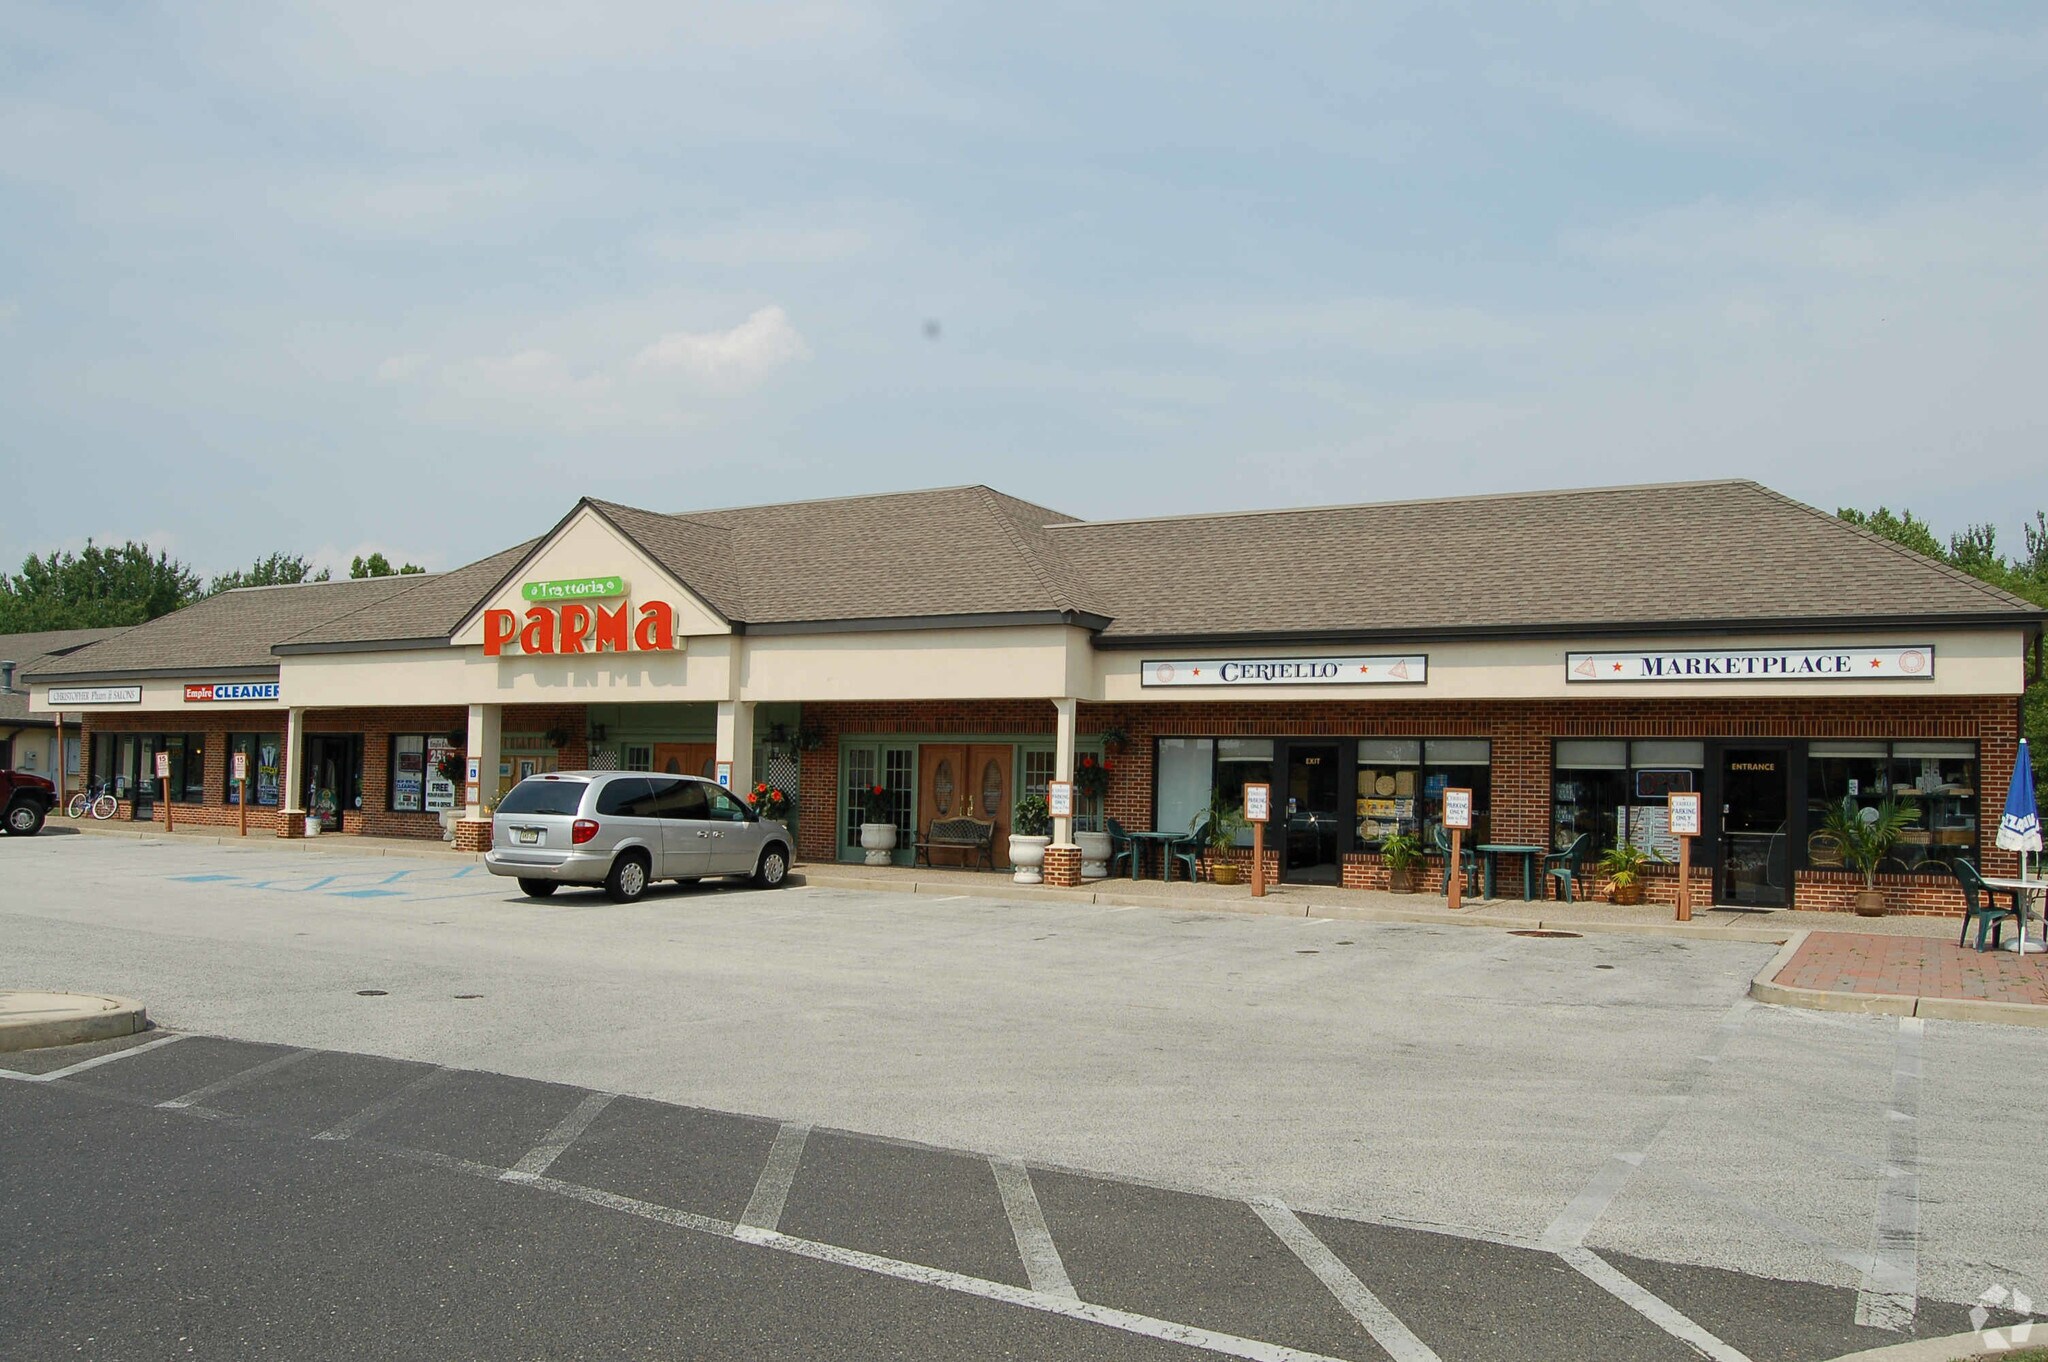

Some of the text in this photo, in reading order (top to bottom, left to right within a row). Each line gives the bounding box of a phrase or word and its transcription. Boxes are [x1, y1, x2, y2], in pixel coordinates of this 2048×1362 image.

[538, 580, 607, 597] Trattoria
[1219, 662, 1338, 682] CERIELLO
[1640, 655, 1852, 677] MARKETPLACE
[186, 687, 212, 700] Empire
[1305, 757, 1320, 765] EXIT
[1731, 763, 1775, 771] ENTRANCE
[431, 782, 449, 792] FREE
